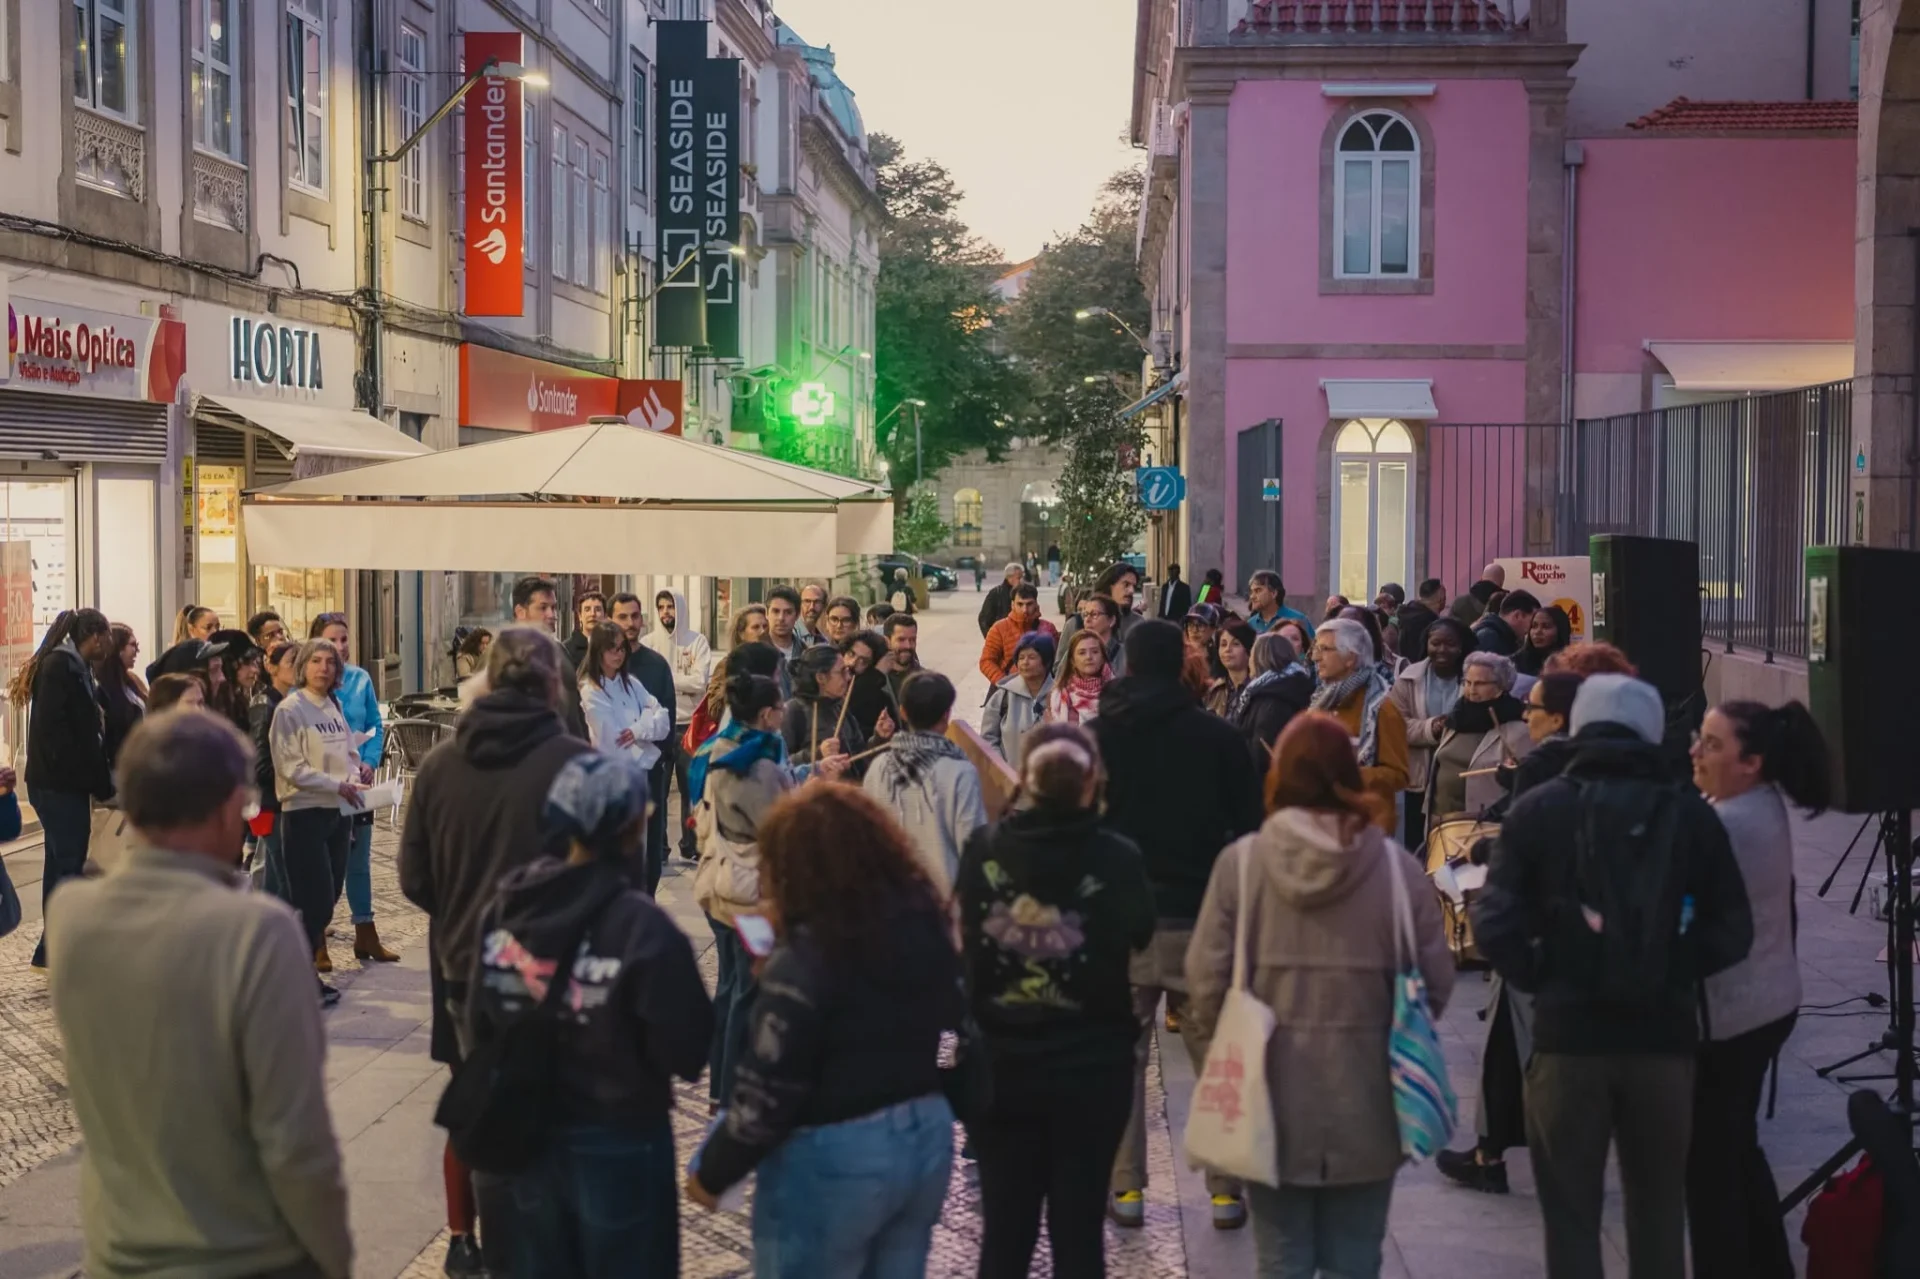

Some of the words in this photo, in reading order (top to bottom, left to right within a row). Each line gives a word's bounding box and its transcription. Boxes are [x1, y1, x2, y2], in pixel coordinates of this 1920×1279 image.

[481, 75, 506, 224] Santander
[669, 79, 693, 214] SEASIDE
[706, 112, 727, 237] SEASIDE
[24, 314, 72, 361] Mais
[76, 323, 135, 374] Optica
[231, 317, 323, 389] HORTA
[538, 380, 578, 417] Santander
